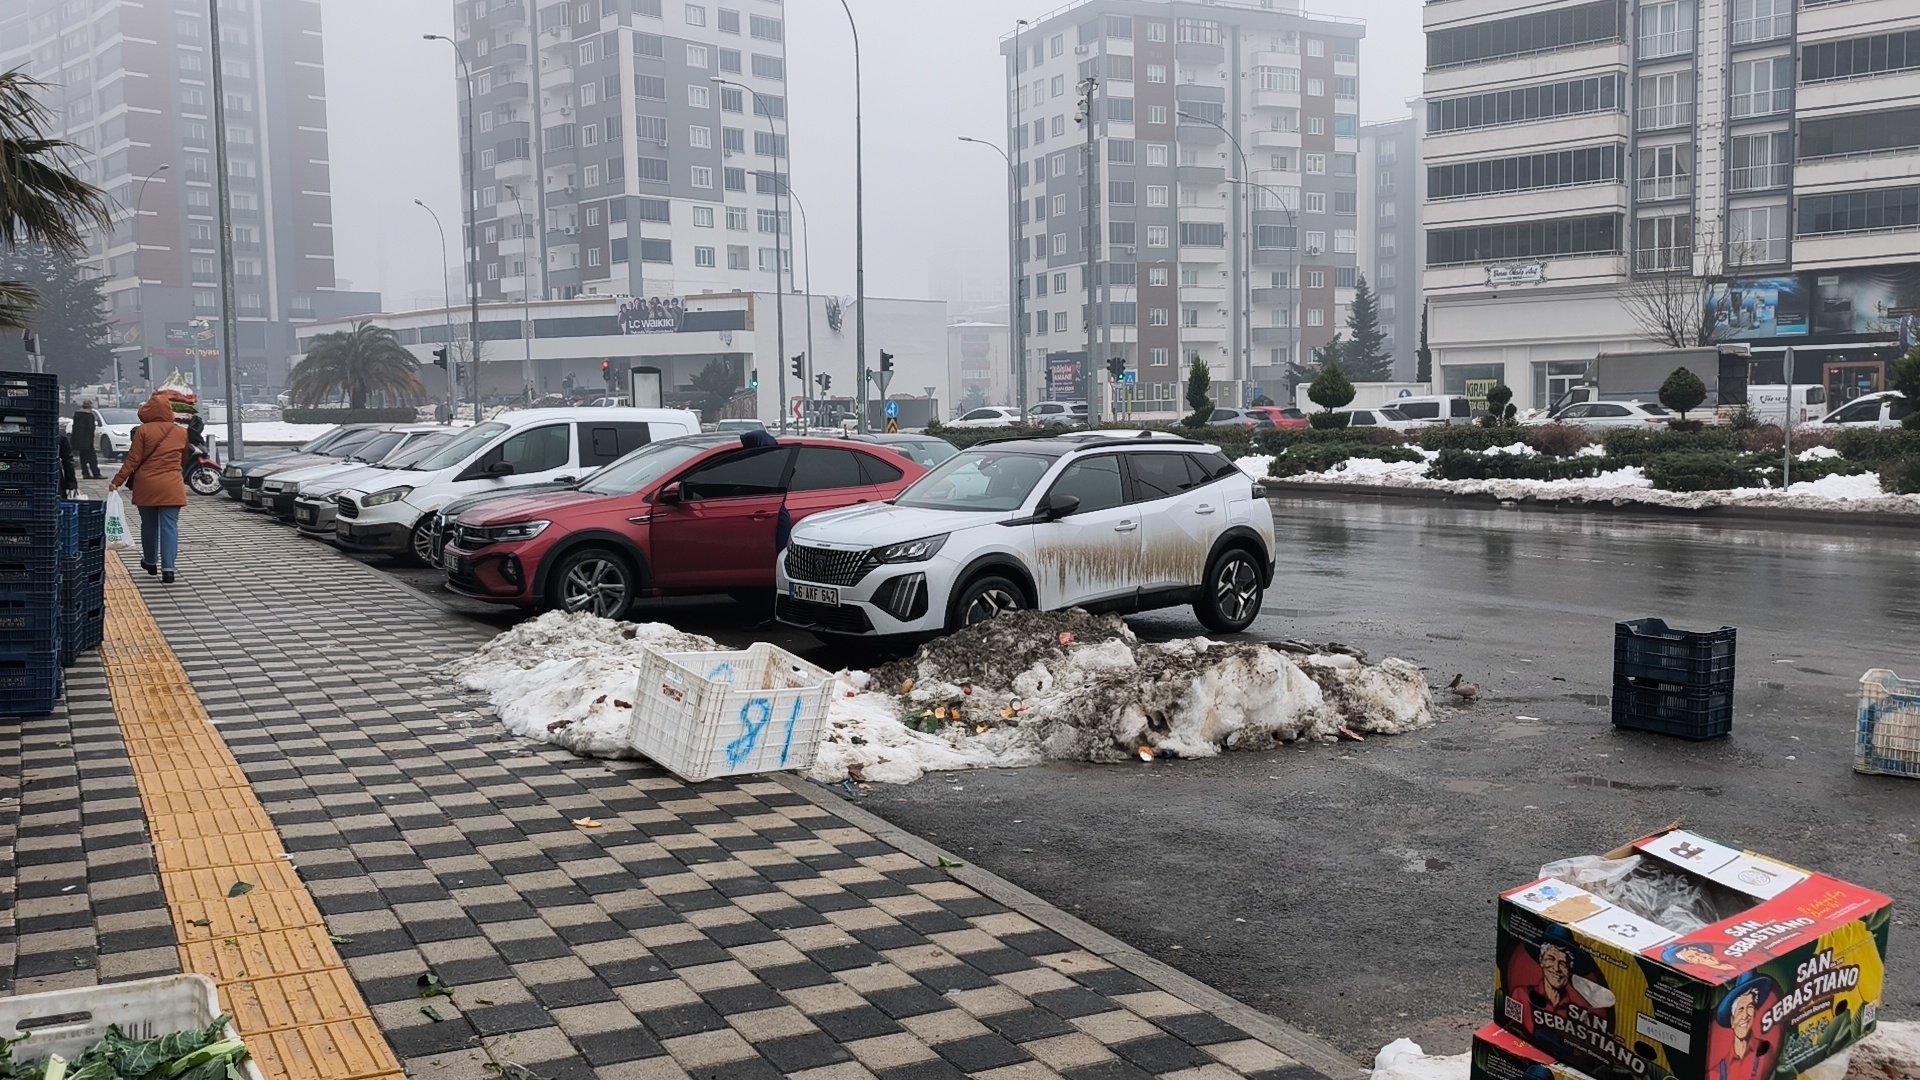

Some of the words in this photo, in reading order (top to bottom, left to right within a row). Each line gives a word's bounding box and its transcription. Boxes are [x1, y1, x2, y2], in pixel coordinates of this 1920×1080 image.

[629, 320, 640, 328] LC
[795, 584, 803, 598] 46
[821, 589, 836, 604] 642
[1723, 917, 1815, 958] SEBASTIANO
[1724, 920, 1763, 938] SAN
[1796, 949, 1833, 984] SAN
[1761, 966, 1860, 1033] SEBASTIANO
[1568, 1003, 1608, 1034] SAN
[1790, 1007, 1814, 1026] Premium
[1533, 1010, 1646, 1074] SEBASTIANO
